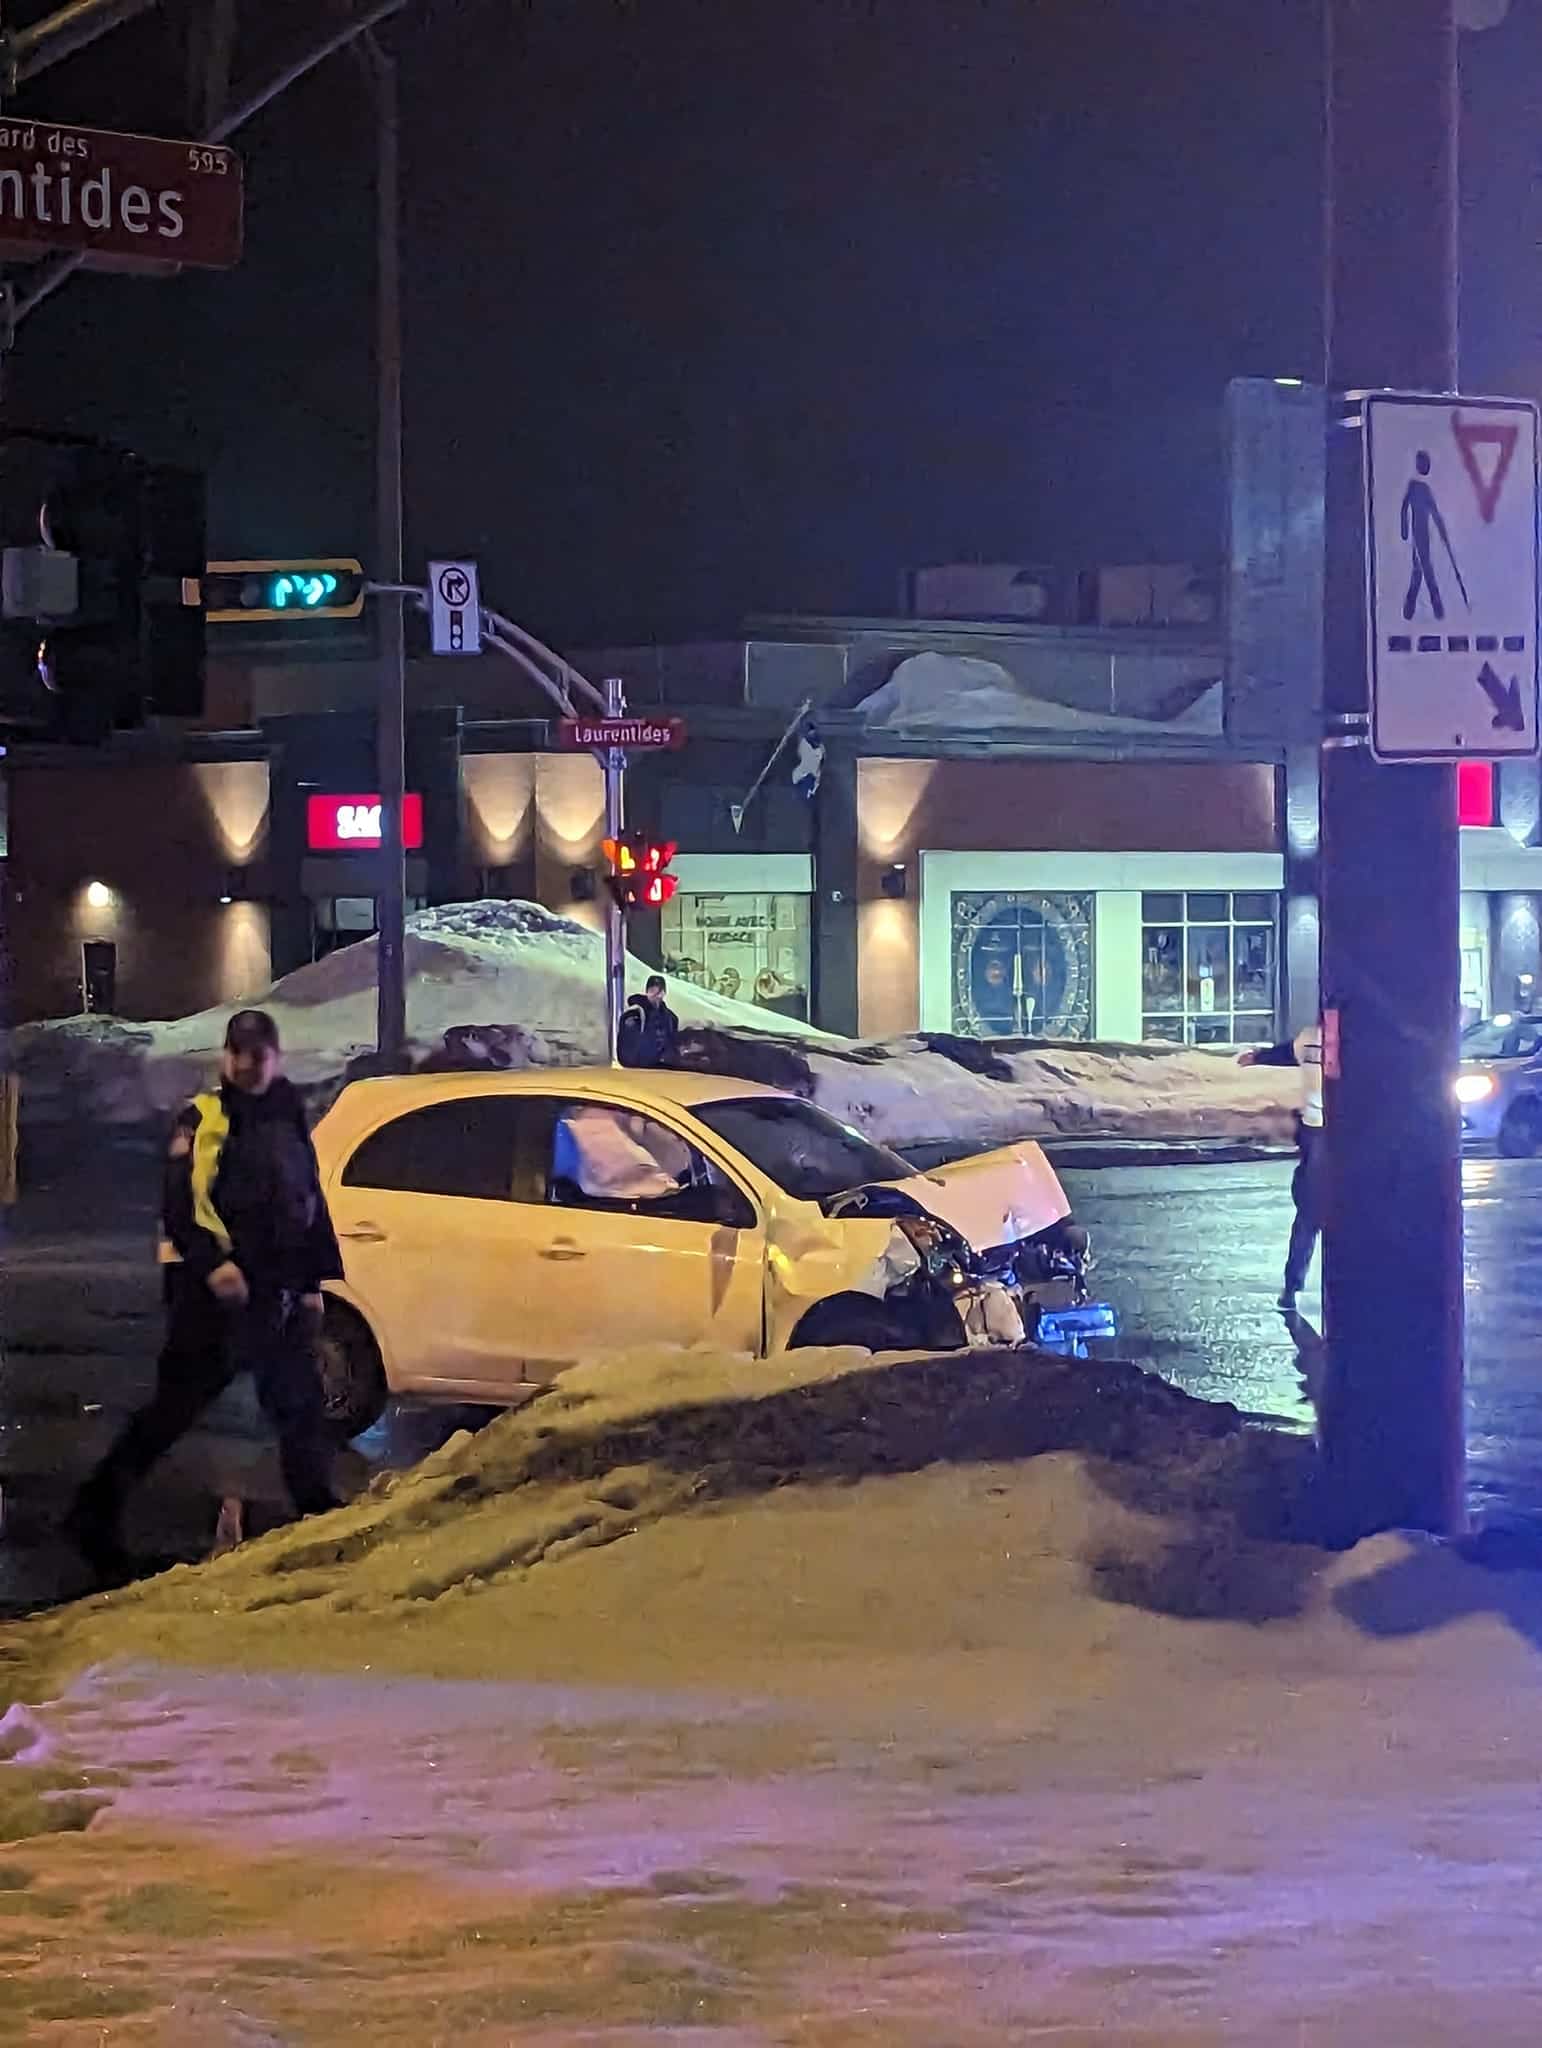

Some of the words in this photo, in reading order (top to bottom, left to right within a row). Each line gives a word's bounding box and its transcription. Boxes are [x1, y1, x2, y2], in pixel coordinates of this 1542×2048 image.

[47, 130, 88, 157] des
[0, 162, 184, 238] ntides
[575, 725, 671, 743] Laurentides
